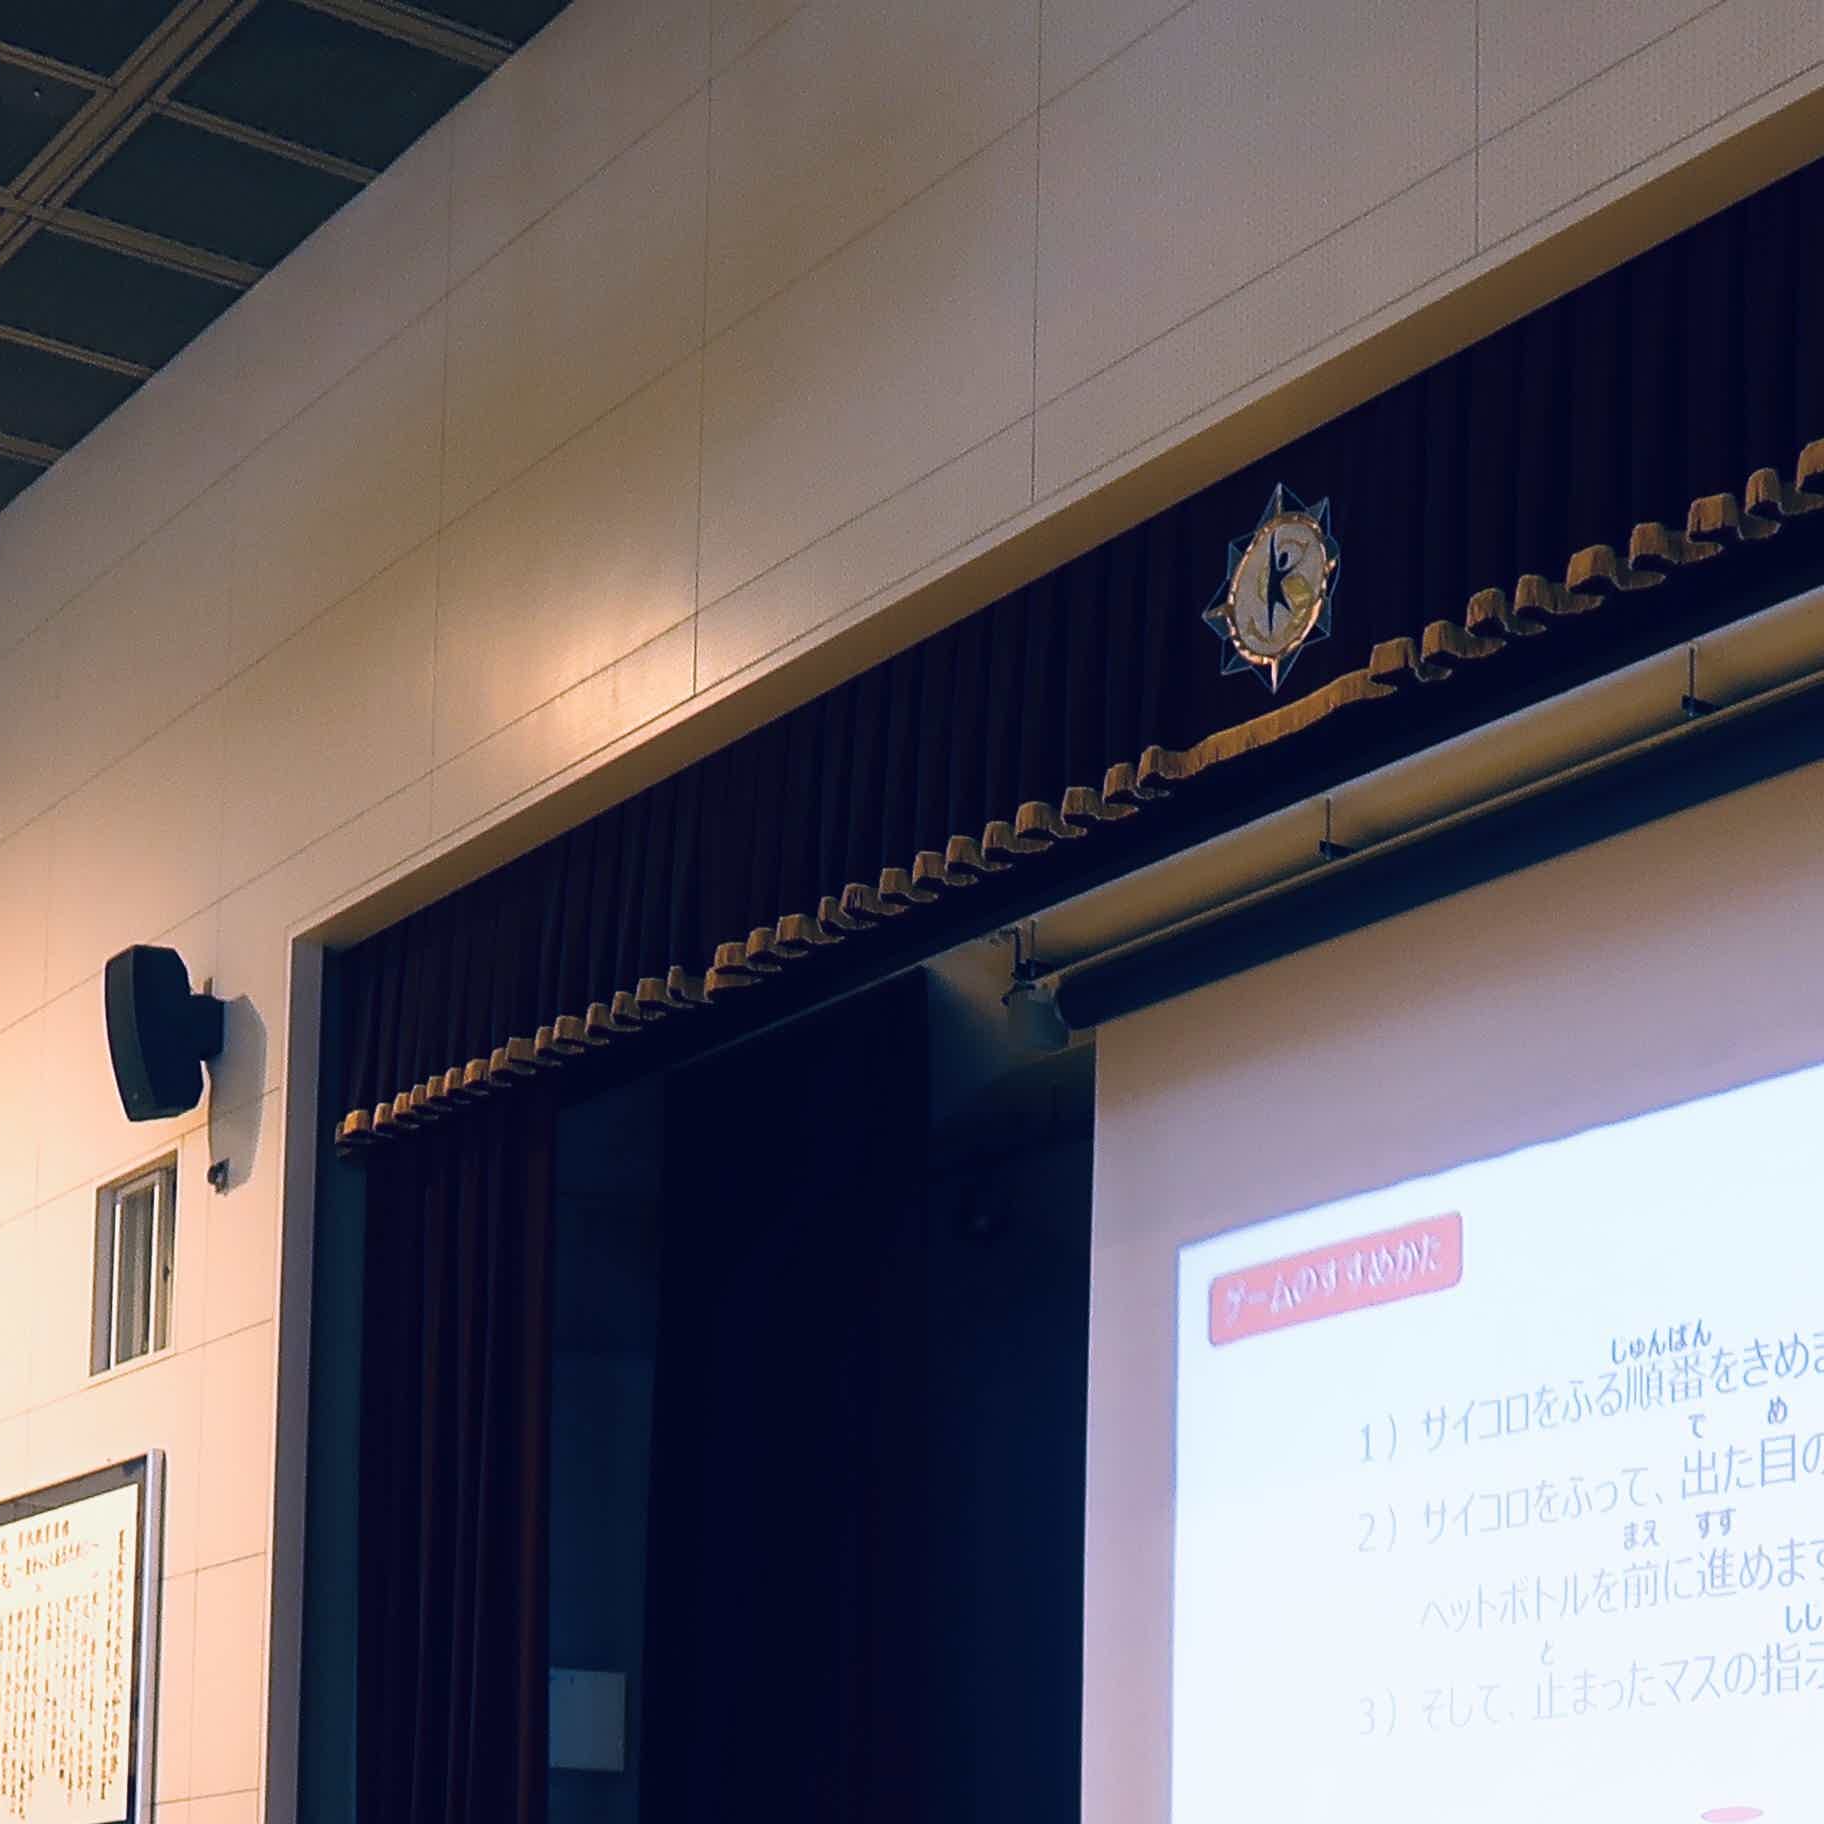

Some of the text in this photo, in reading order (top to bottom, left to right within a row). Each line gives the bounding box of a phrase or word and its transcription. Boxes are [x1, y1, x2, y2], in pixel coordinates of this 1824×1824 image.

[1611, 1319, 1711, 1363] じゅんばん
[1687, 1413, 1707, 1438] て
[1767, 1397, 1788, 1425] め
[1624, 1507, 1737, 1550] まえ すす
[1784, 1602, 1823, 1634] しし
[1539, 1640, 1555, 1666] と
